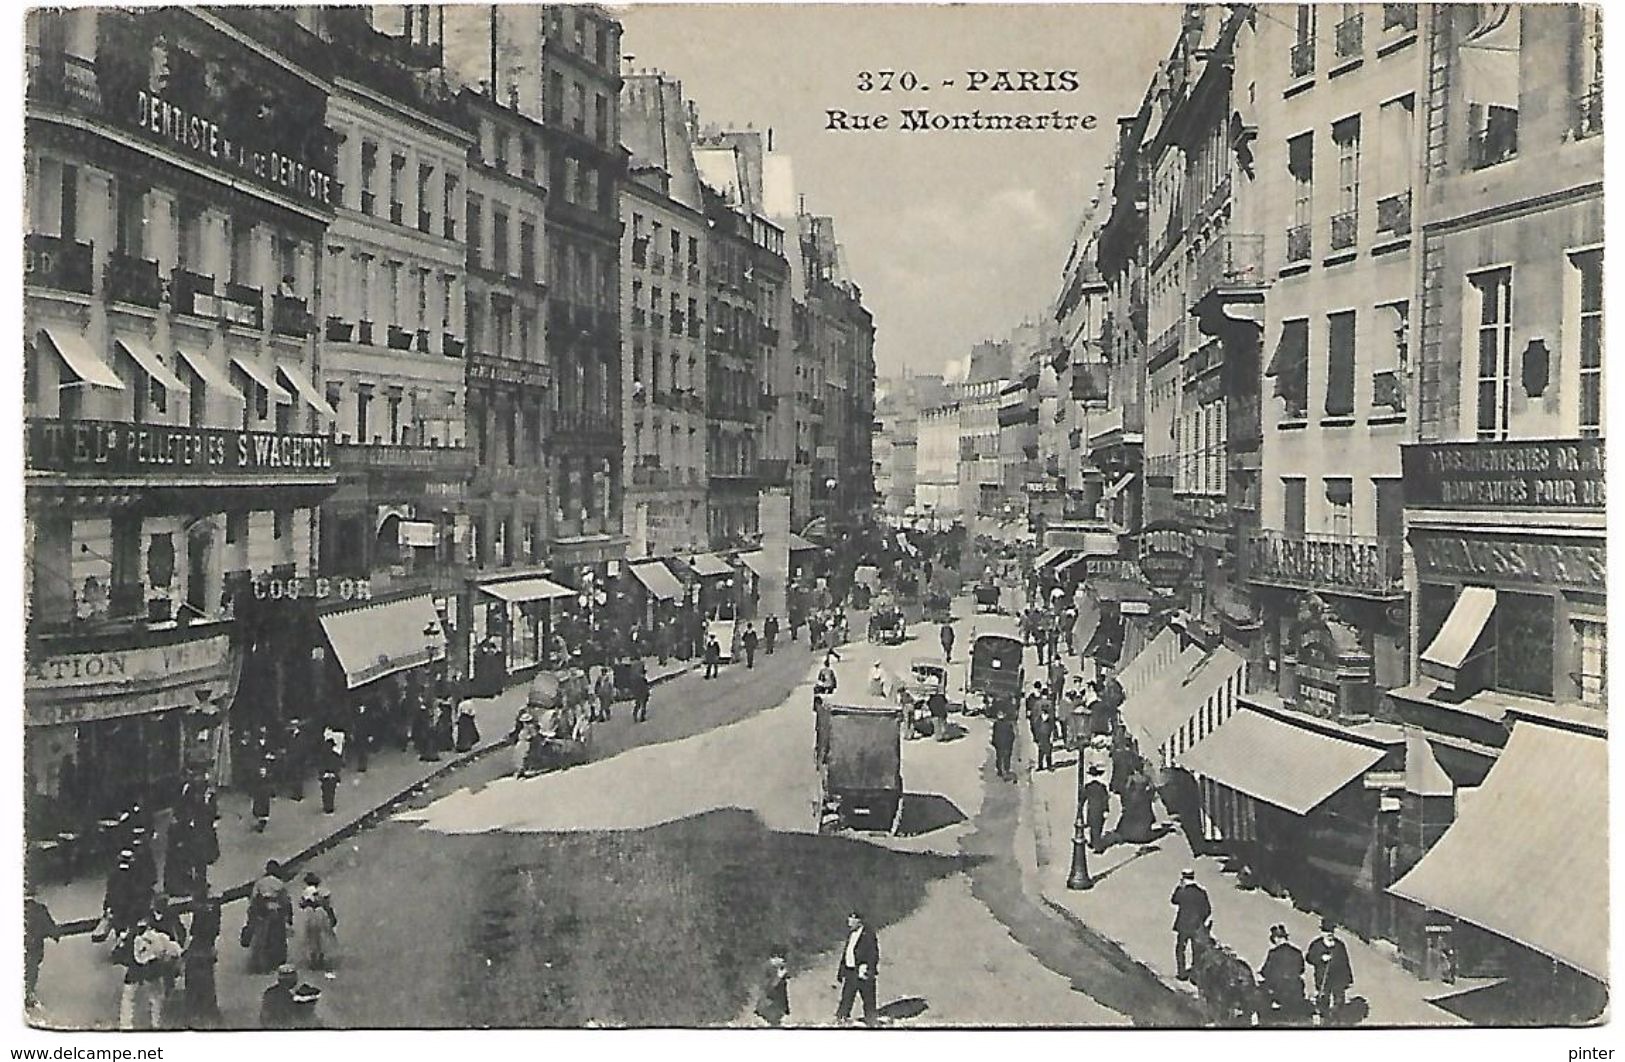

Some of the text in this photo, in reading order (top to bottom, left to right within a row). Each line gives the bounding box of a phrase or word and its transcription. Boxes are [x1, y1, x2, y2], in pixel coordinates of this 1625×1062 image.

[138, 90, 218, 158] DENTISTE
[270, 151, 330, 204] DENTISTE
[127, 431, 224, 464] PELLETERIES
[253, 435, 331, 467] WACHTEL
[1535, 479, 1577, 504] POUR
